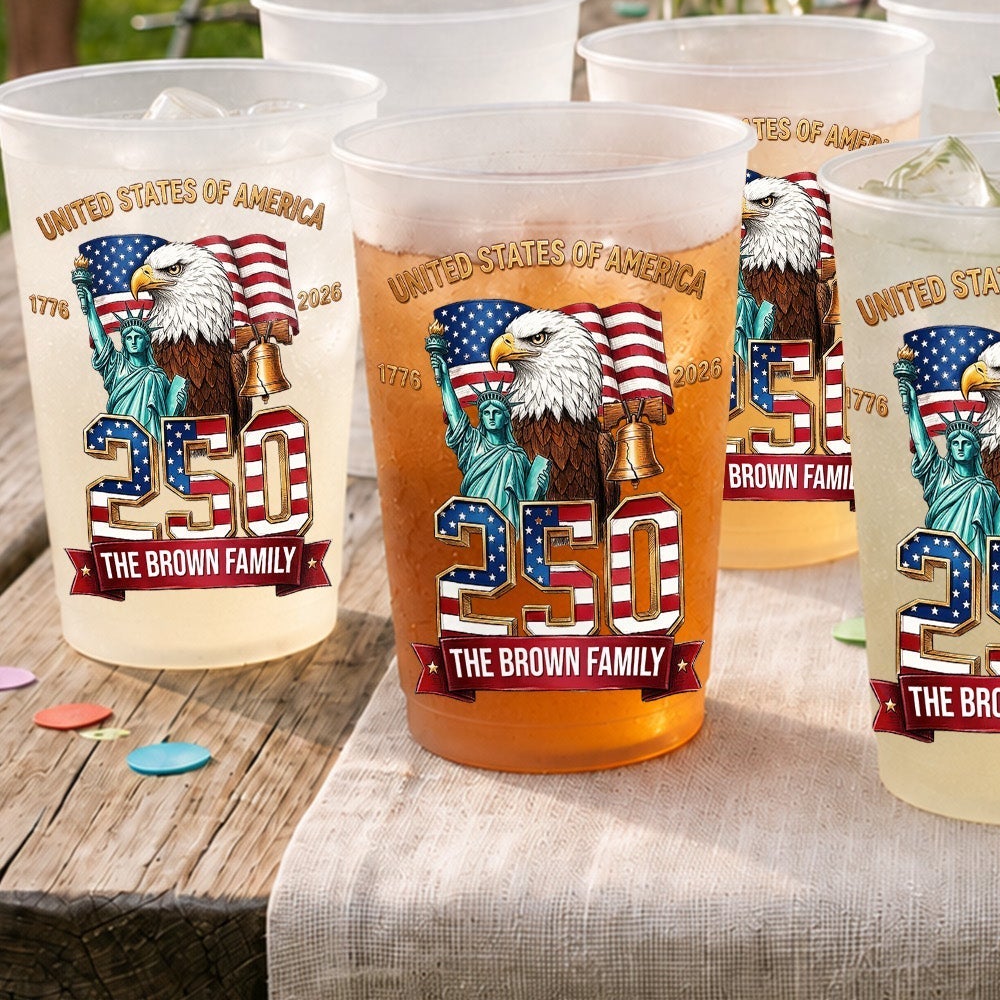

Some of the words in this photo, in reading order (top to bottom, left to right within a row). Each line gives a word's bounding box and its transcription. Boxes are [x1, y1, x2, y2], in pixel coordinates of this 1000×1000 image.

[740, 117, 791, 141] TES
[796, 118, 824, 143] OF
[36, 192, 114, 241] UNITED
[117, 178, 198, 211] STATES
[202, 178, 231, 205] OF
[233, 183, 326, 231] AMERICA
[387, 252, 473, 304] UNITED
[478, 239, 565, 274] STATES
[571, 239, 602, 269] OF
[604, 243, 707, 300] AMERICA
[28, 294, 70, 320] 1776
[297, 281, 342, 312] 2026
[855, 274, 947, 327] UNITED
[377, 362, 422, 391] 1776
[672, 357, 721, 388] 2026
[82, 405, 314, 543] 250
[728, 463, 798, 489] BROWN
[803, 463, 855, 491] FAMI
[101, 551, 143, 579] THE
[146, 548, 219, 577] BROWN
[225, 546, 297, 575] FAMILY
[433, 493, 686, 638] 250
[449, 648, 494, 679] THE
[500, 647, 580, 678] BROWN
[587, 646, 666, 677] FAMILY
[908, 685, 954, 718] THE
